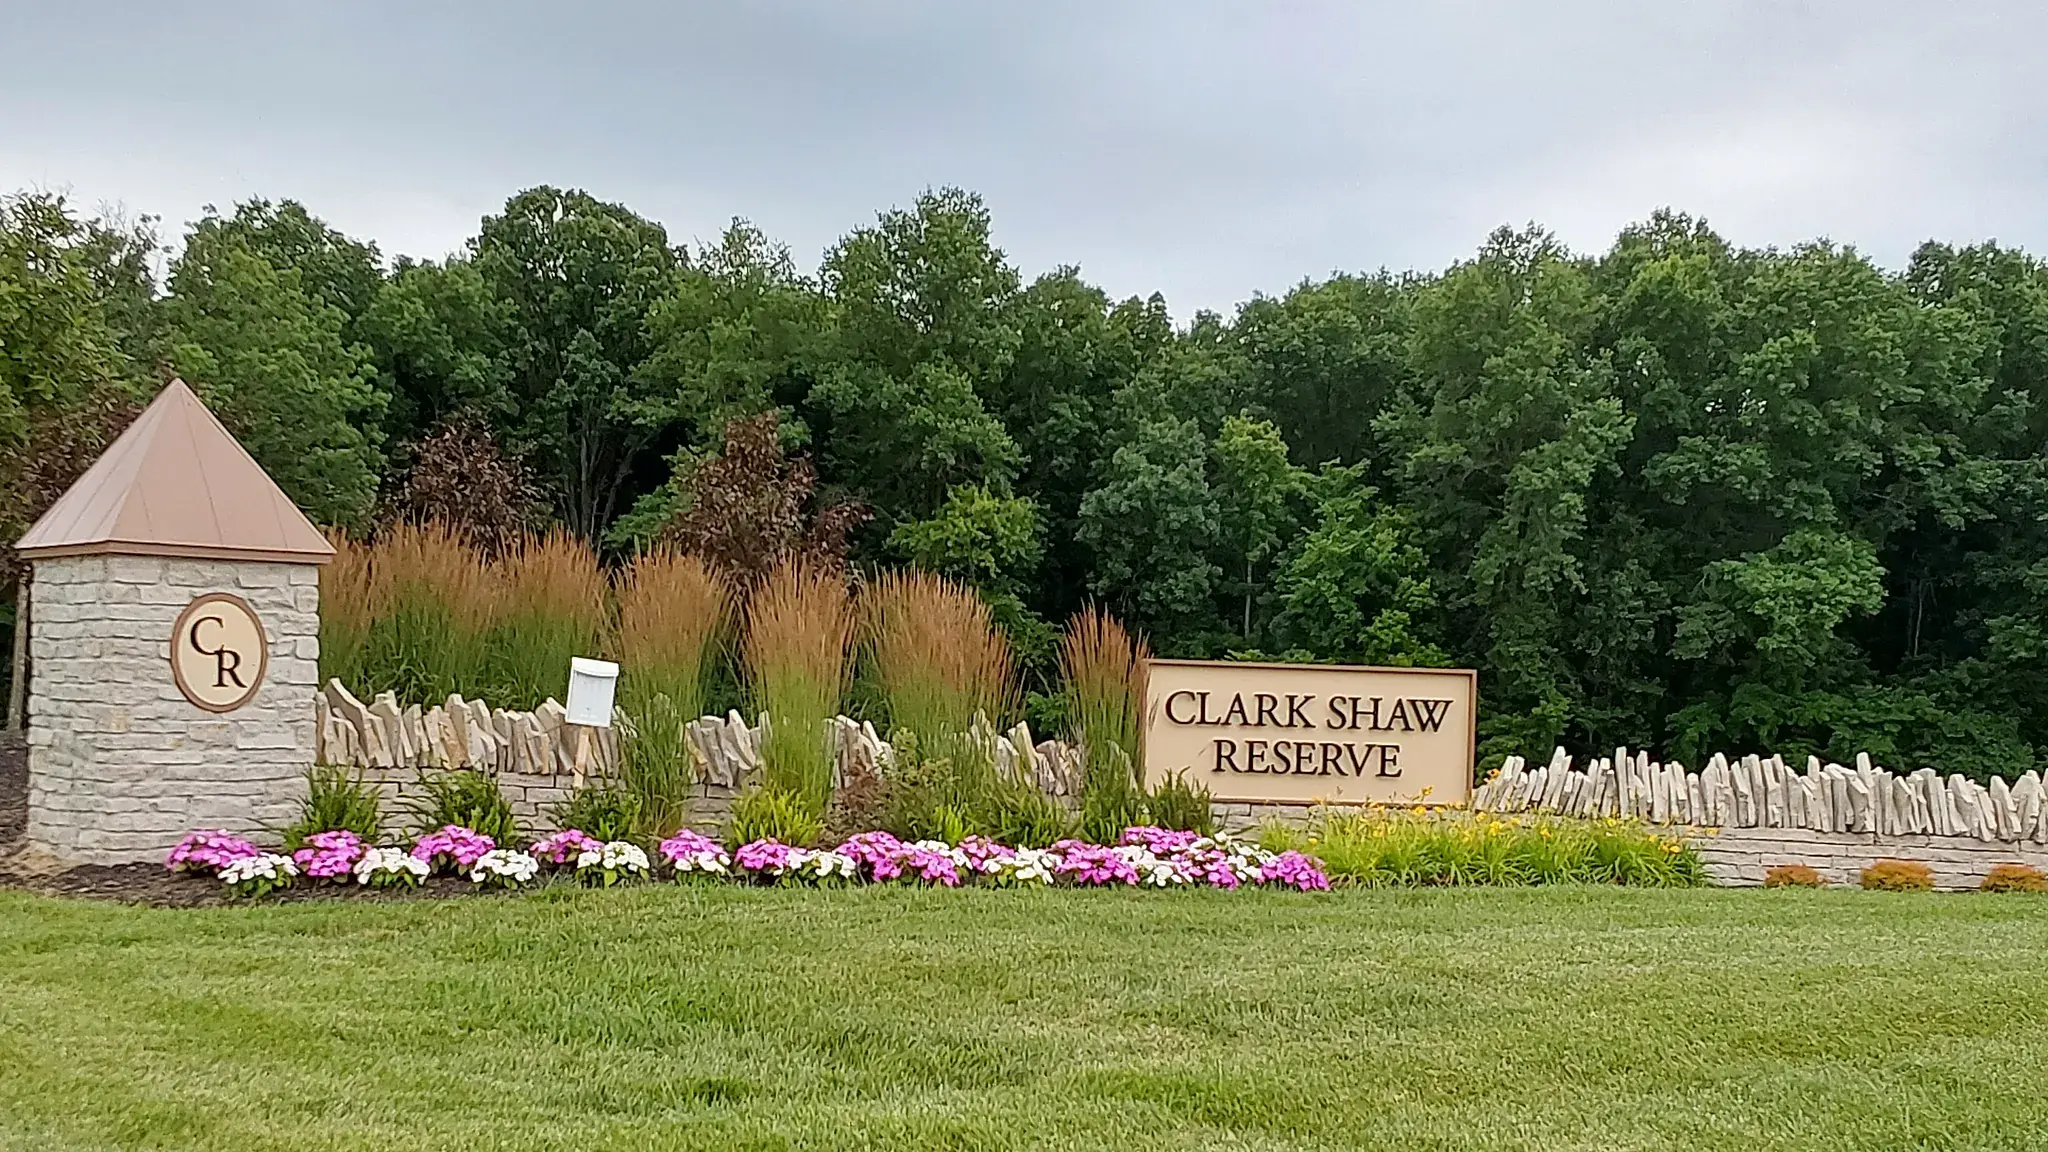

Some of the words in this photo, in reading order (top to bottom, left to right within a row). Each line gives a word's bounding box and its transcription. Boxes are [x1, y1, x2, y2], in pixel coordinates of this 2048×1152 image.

[1165, 690, 1316, 729] CLARK
[1326, 696, 1454, 733] SHAW
[1212, 739, 1403, 778] RESERVE
